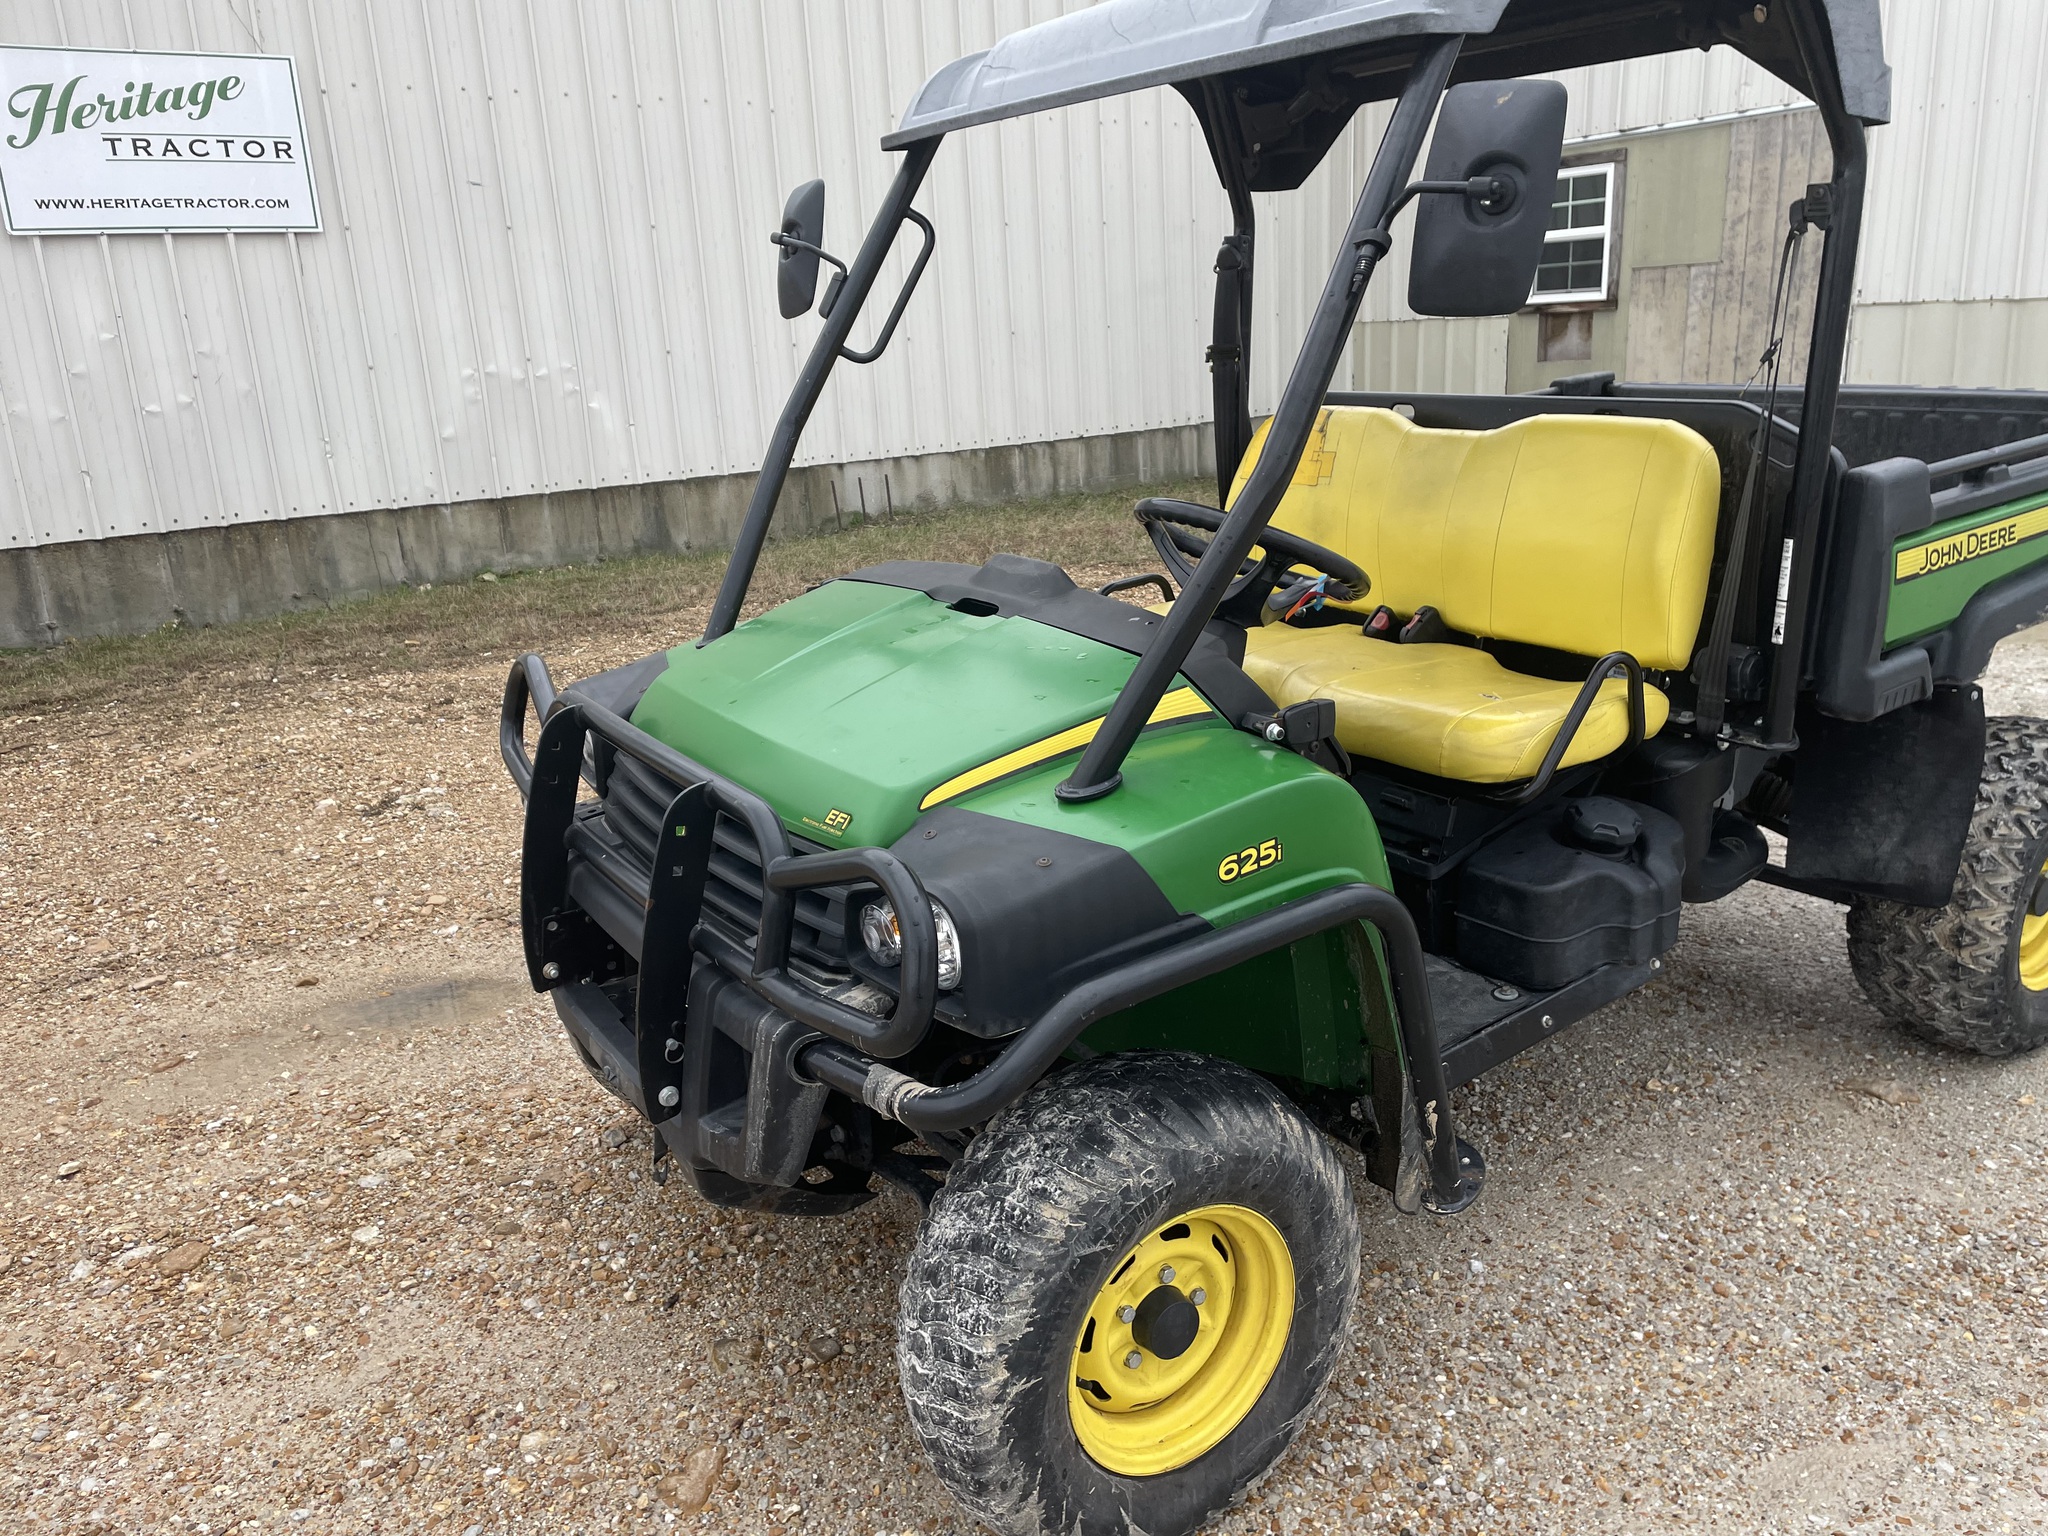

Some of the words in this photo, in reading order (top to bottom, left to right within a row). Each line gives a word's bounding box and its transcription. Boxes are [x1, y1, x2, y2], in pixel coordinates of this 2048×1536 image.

[6, 75, 246, 149] Heritage
[102, 137, 294, 159] TRACTOR
[34, 198, 290, 209] WWW.HERITAGETRACTOR.COM
[824, 808, 852, 831] EFI
[1218, 838, 1282, 882] 625i
